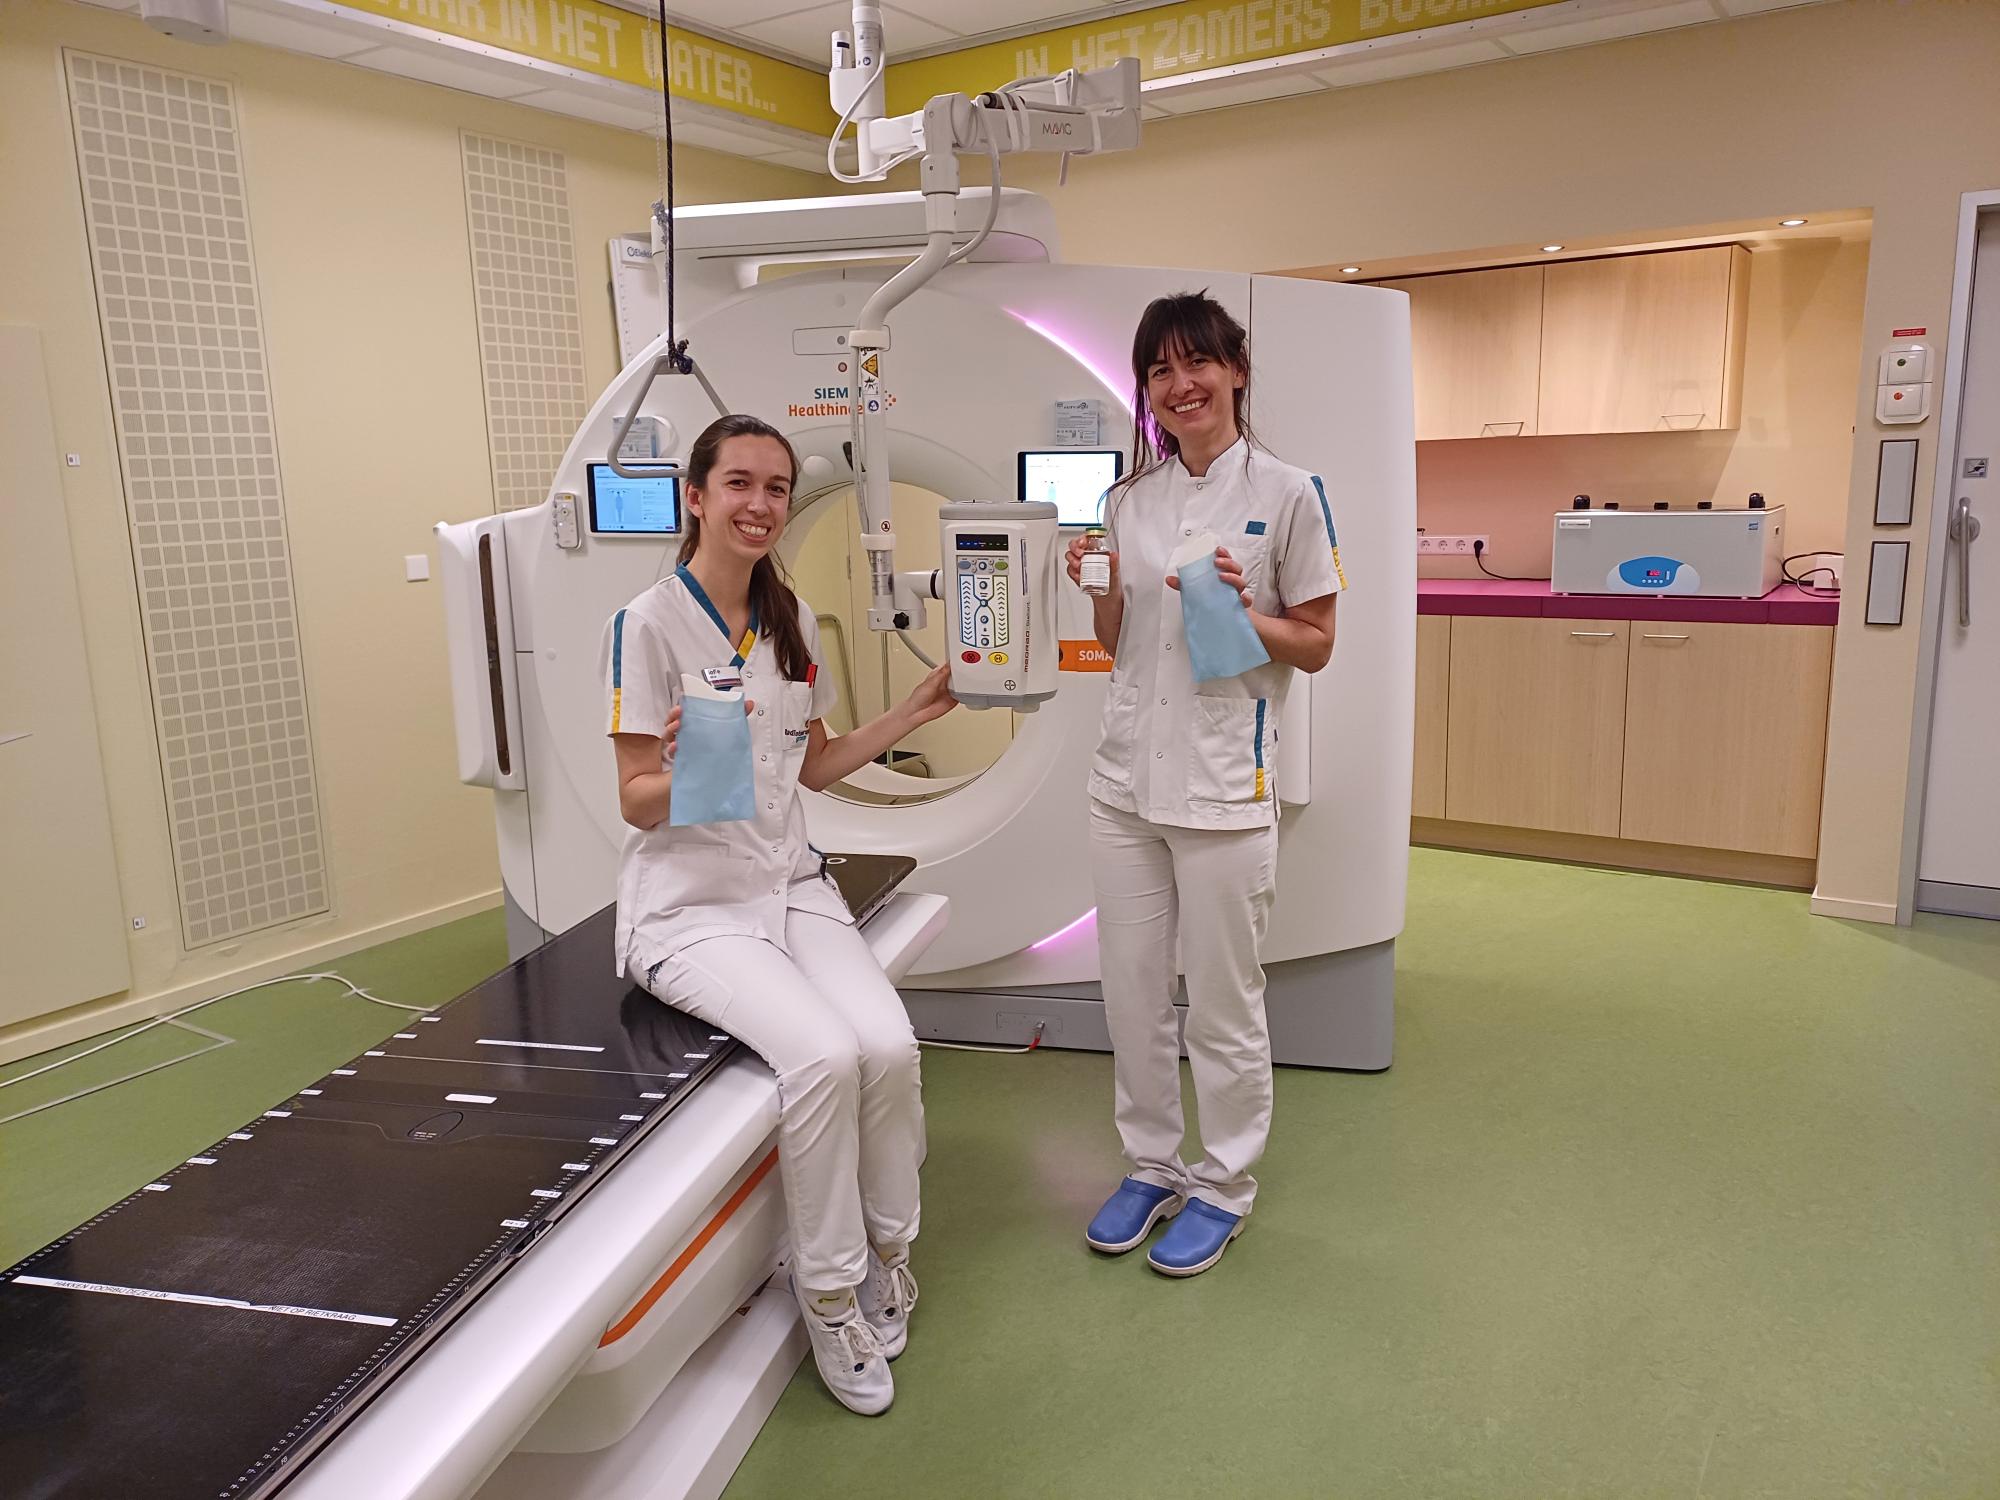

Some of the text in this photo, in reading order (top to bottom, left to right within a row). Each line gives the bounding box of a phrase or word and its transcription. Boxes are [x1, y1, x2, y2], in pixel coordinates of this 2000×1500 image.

[550, 2, 621, 68] HET
[1153, 0, 1331, 70] ZOMERS
[1079, 649, 1114, 662] SOMA
